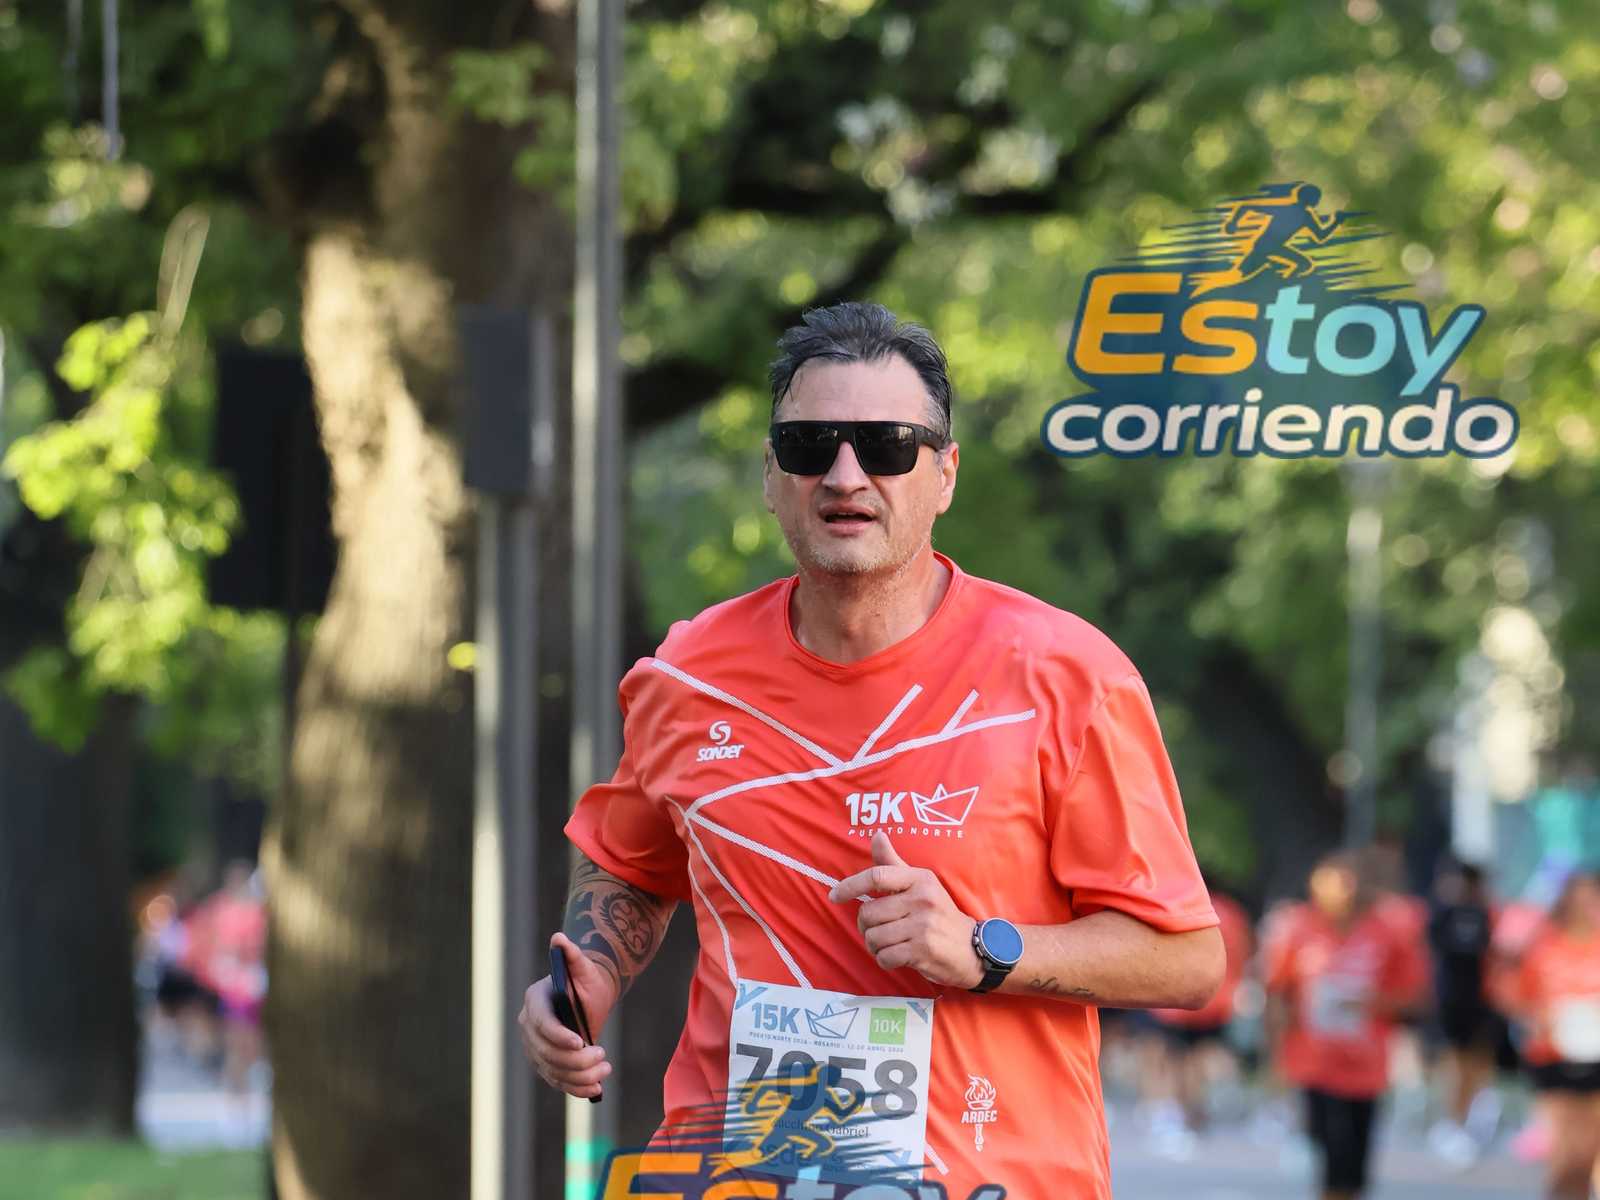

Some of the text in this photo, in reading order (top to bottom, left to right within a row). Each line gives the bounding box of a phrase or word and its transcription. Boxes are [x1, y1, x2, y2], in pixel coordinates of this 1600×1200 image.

[846, 791, 908, 826] 15K
[910, 827, 964, 839] NORTE
[751, 1002, 801, 1035] 15K
[873, 1018, 902, 1034] 10K
[735, 1042, 918, 1121] 7058
[961, 1109, 998, 1124] ARDEC
